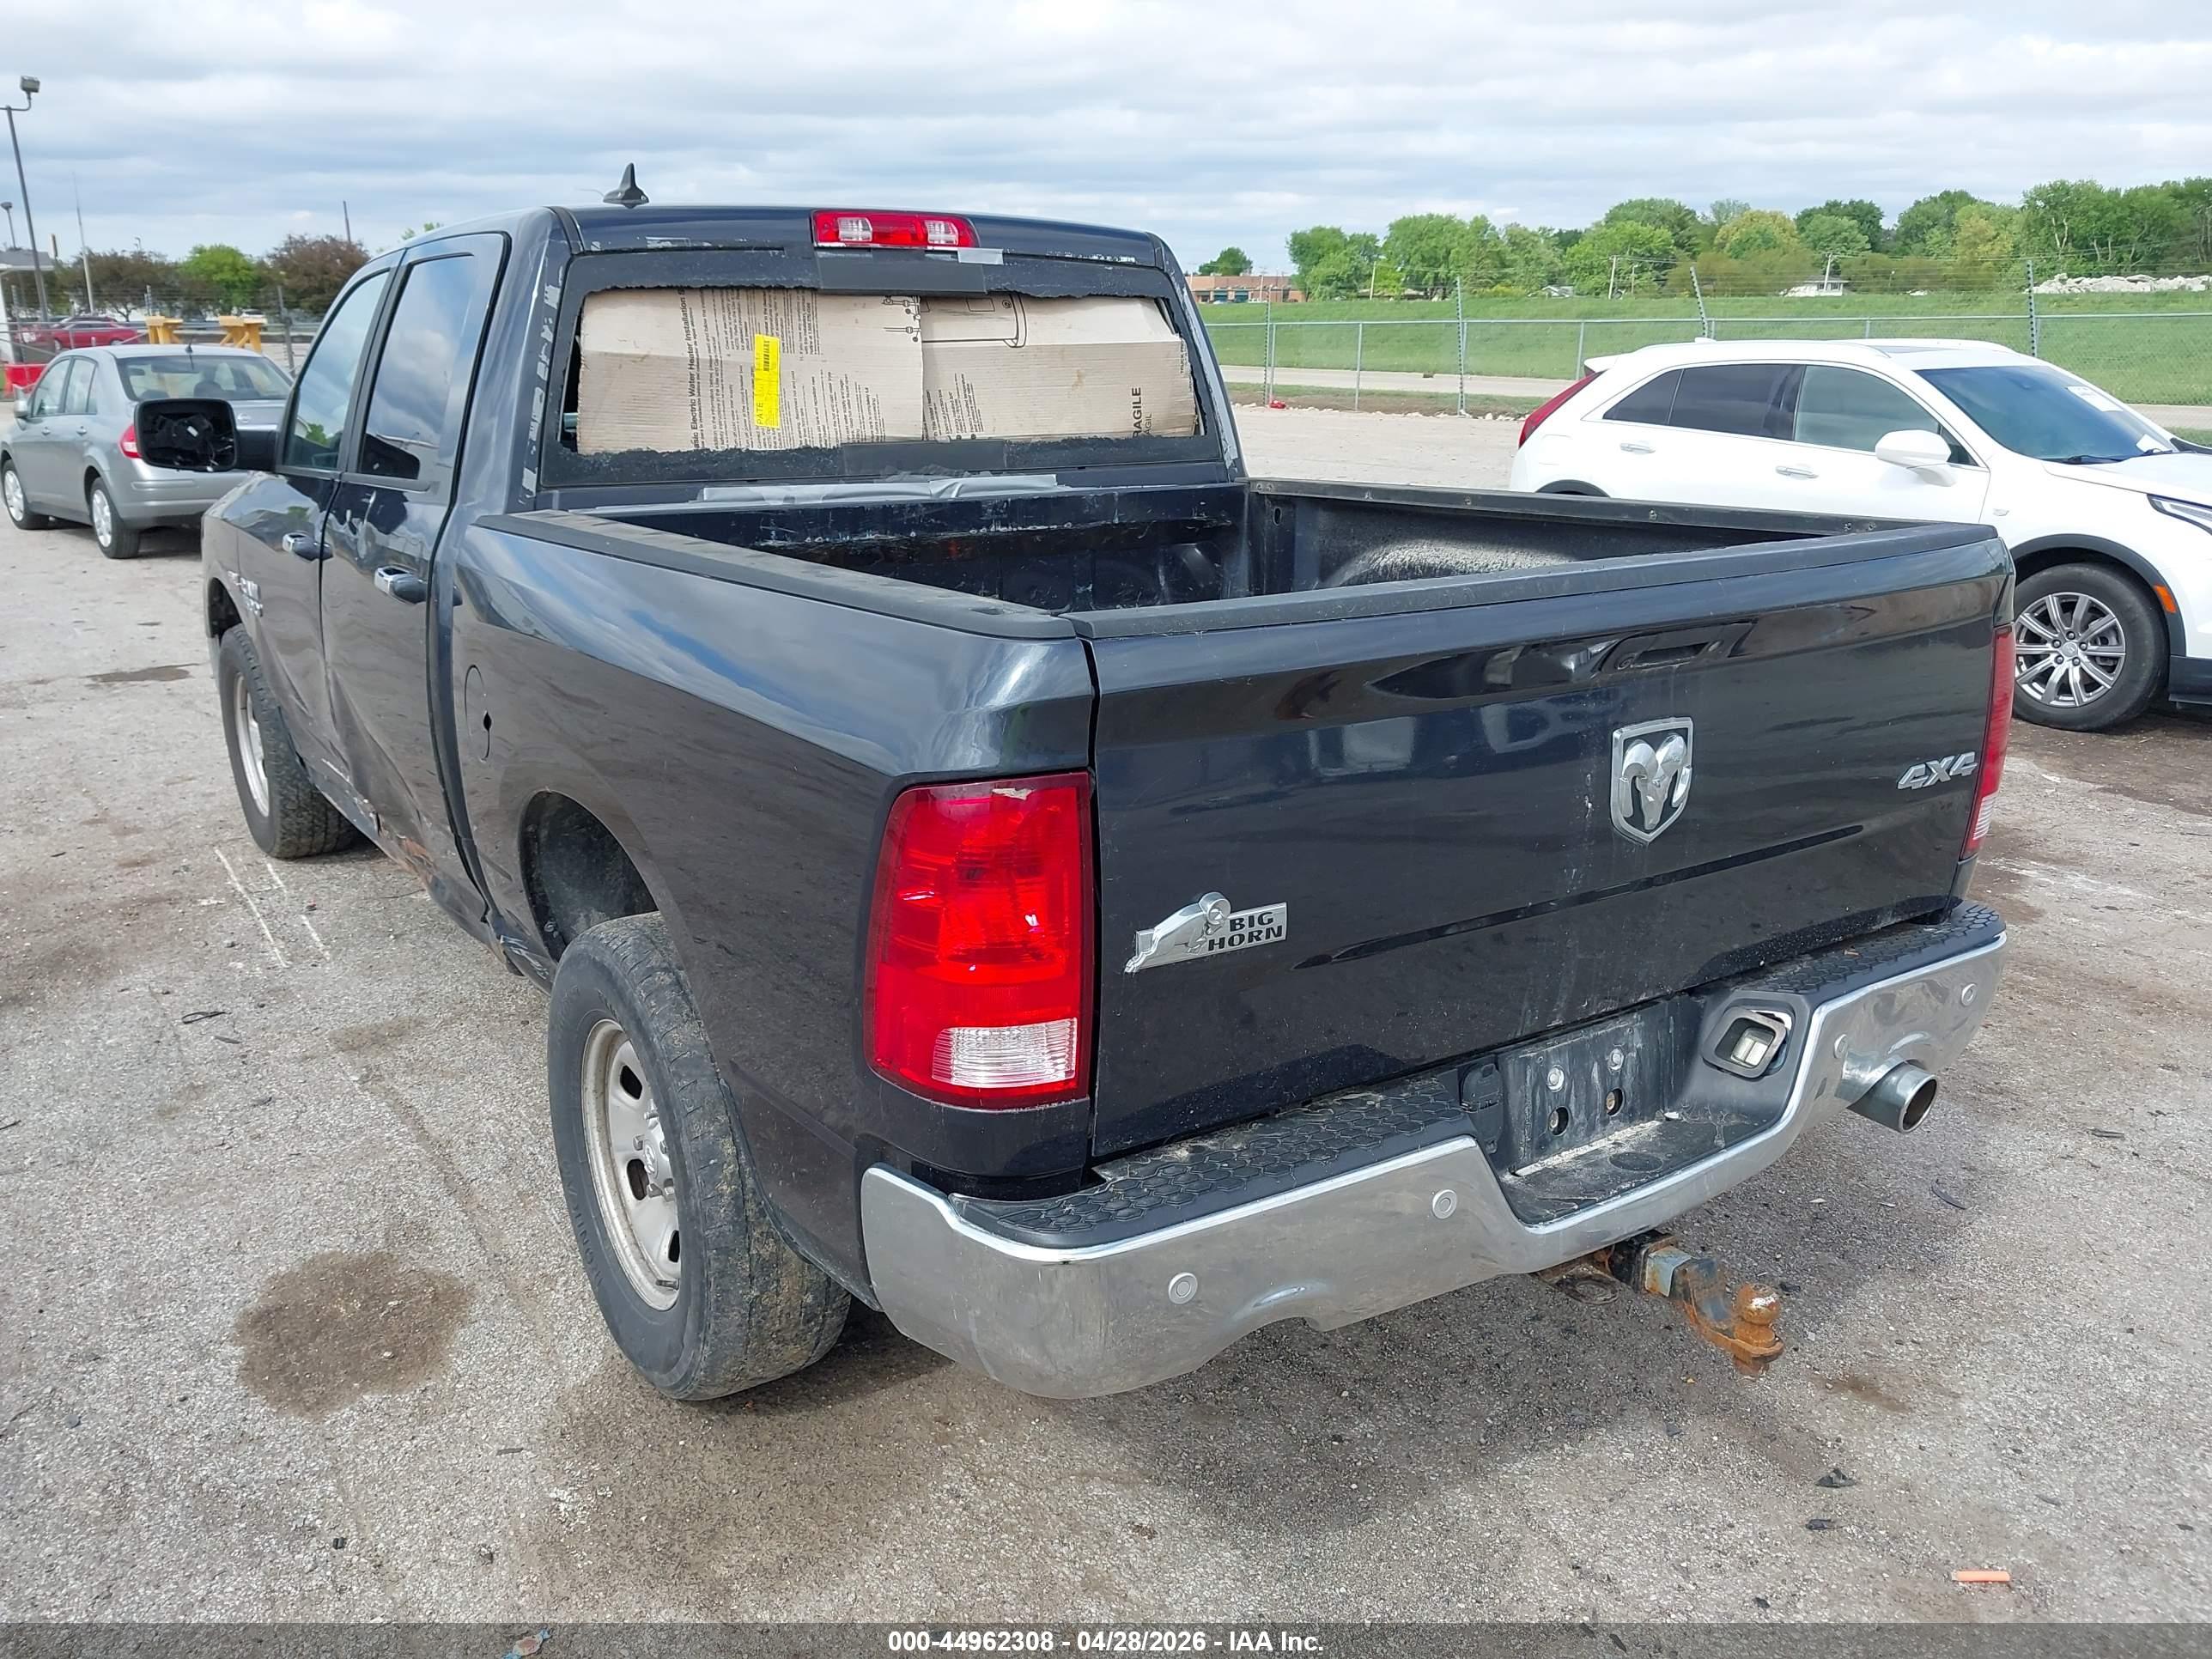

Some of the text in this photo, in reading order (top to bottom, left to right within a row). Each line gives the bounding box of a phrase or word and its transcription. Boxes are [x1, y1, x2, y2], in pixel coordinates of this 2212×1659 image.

[679, 297, 691, 341] Installation
[686, 343, 695, 370] Heater
[689, 398, 698, 430] Electric
[1897, 751, 1978, 790] 4X4
[1230, 912, 1274, 933] BIG
[1208, 925, 1283, 952] HORN
